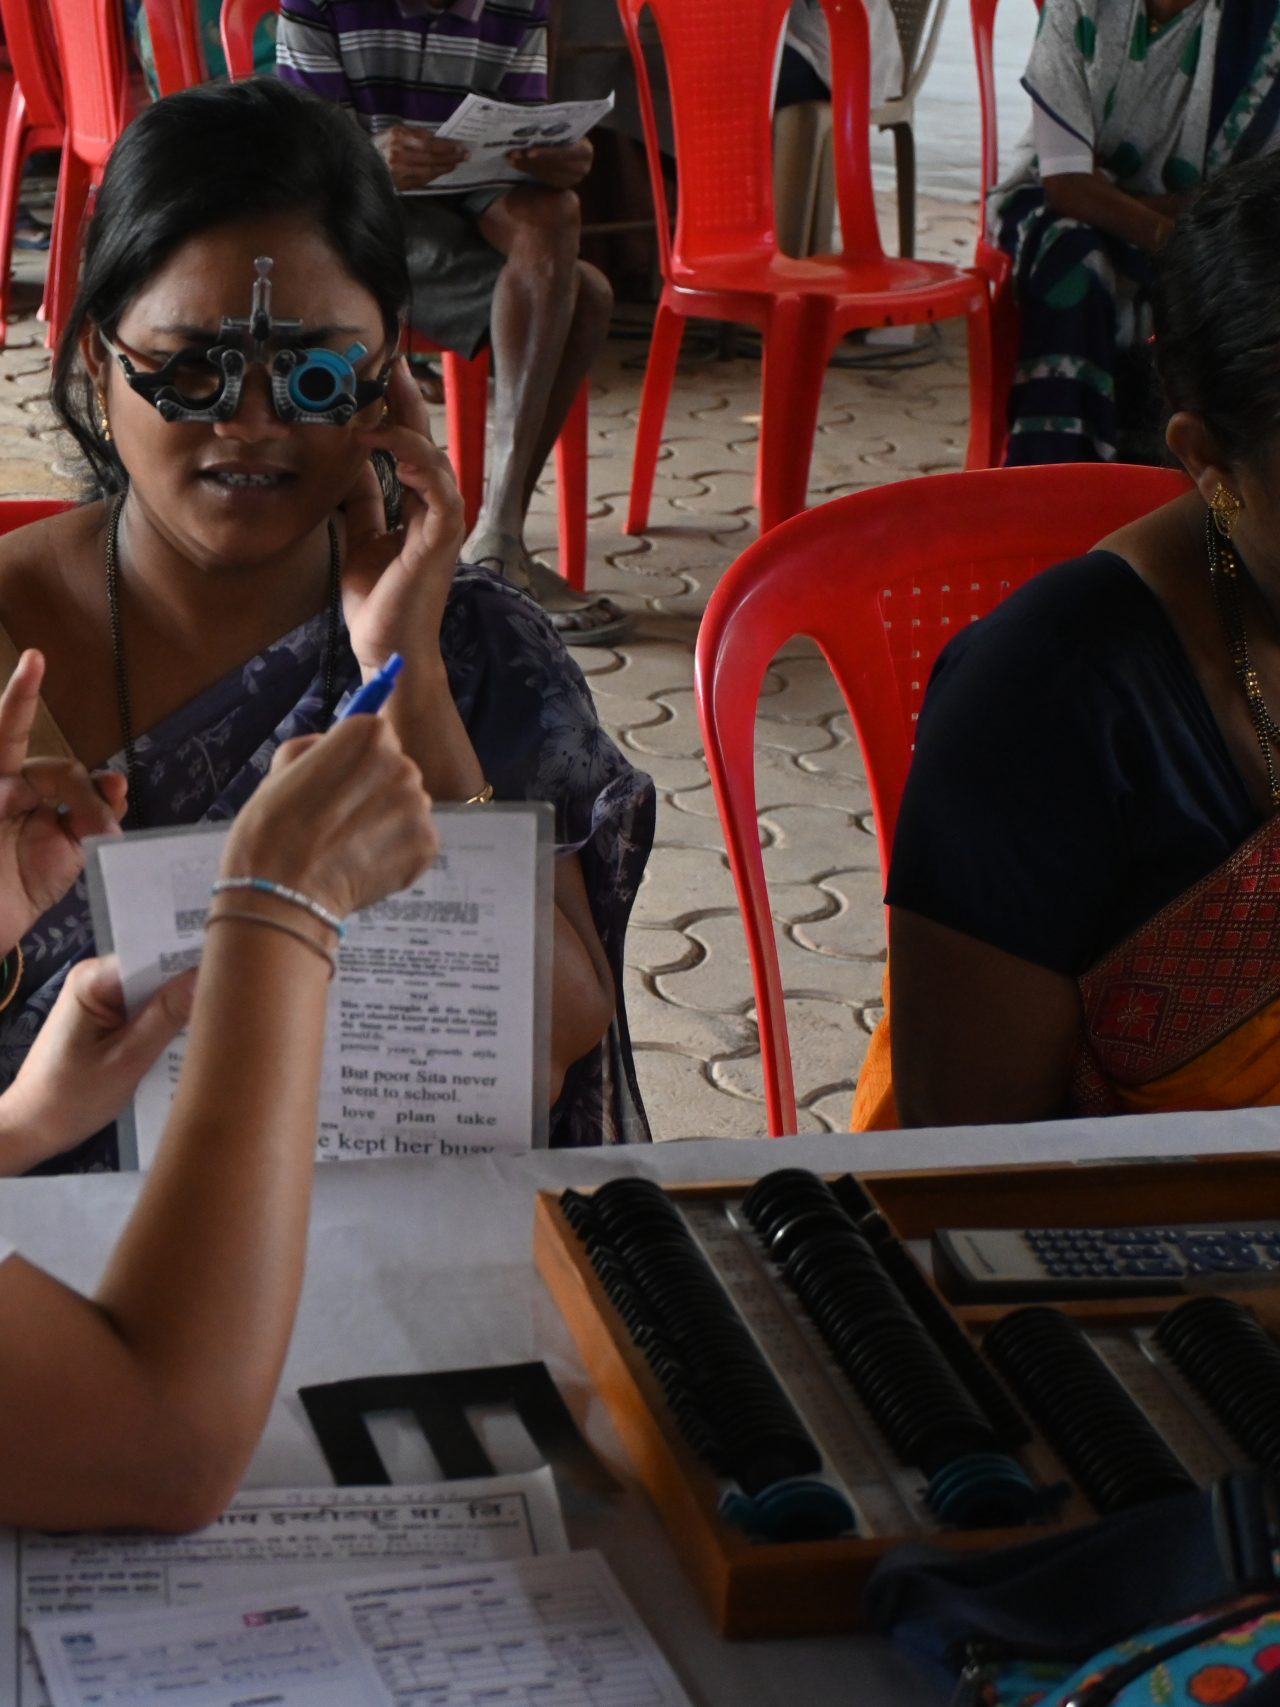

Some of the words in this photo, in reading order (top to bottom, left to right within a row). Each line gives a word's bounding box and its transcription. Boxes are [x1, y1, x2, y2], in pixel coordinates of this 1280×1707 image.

[341, 1065, 369, 1080] But
[373, 1068, 410, 1084] poor
[416, 1070, 447, 1084] Sita
[452, 1073, 498, 1087] never
[341, 1085, 379, 1099] went
[383, 1085, 399, 1099] to
[342, 1105, 376, 1119] love
[395, 1109, 436, 1125] plan
[456, 1112, 498, 1127] take
[338, 1132, 387, 1156] kept
[394, 1136, 434, 1155] her
